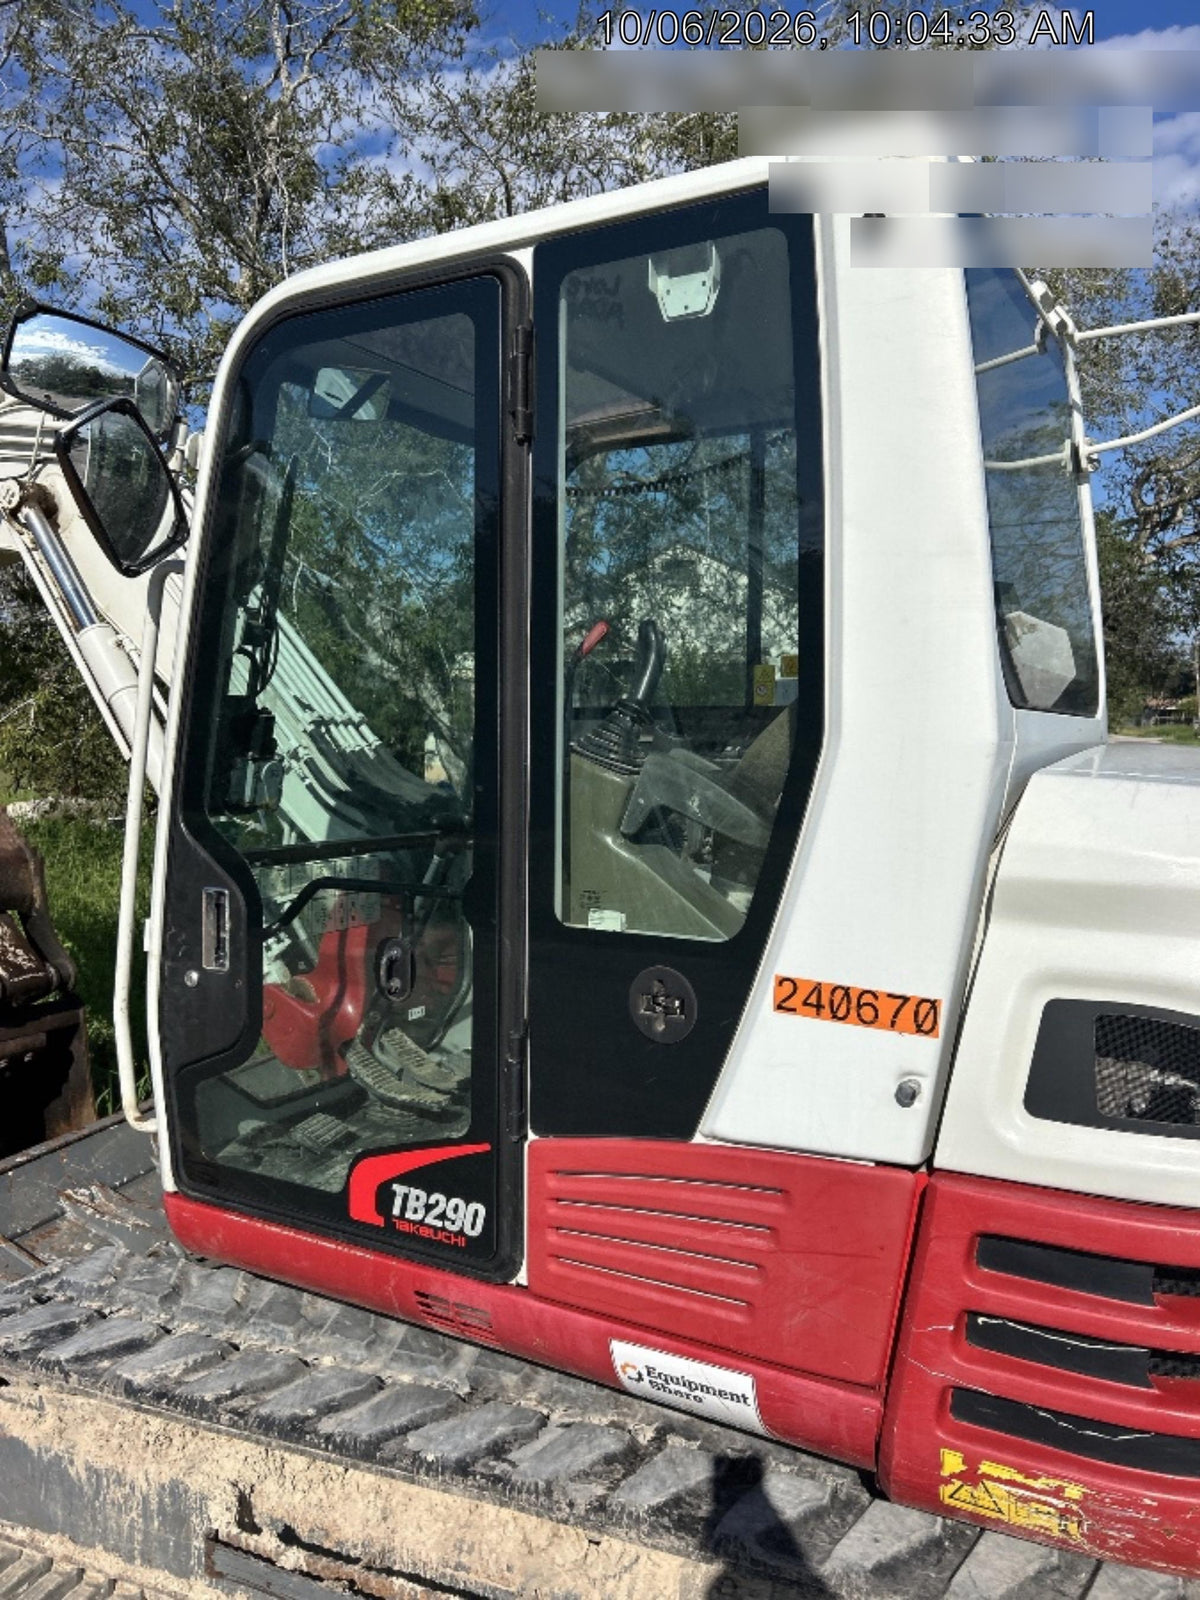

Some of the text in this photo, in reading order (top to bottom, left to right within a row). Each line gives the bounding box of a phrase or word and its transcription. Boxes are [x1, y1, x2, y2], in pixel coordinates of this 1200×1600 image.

[776, 977, 938, 1035] 240670
[391, 1183, 486, 1236] TB290
[645, 1364, 751, 1406] Equipment
